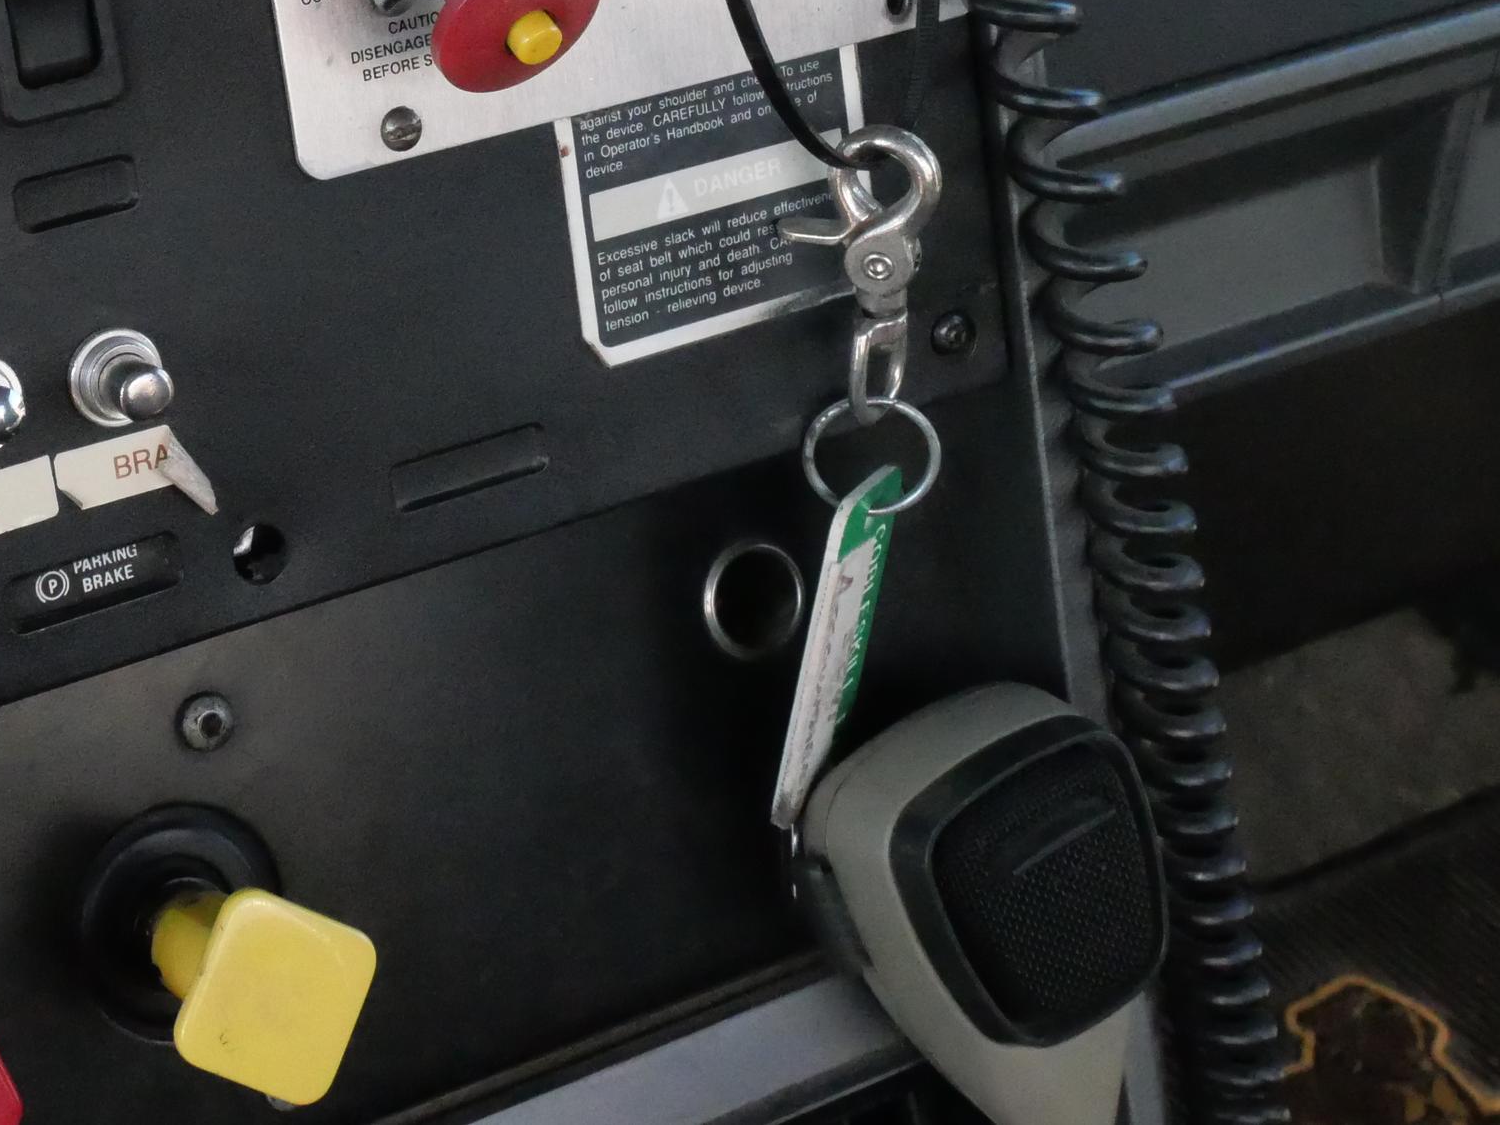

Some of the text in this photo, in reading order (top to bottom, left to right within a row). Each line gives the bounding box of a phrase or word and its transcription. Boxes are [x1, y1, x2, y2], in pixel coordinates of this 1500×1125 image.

[388, 11, 440, 35] CAUTIO
[362, 58, 420, 82] BEFORE
[628, 103, 652, 121] your
[658, 88, 707, 111] shoulder
[714, 81, 735, 96] and
[740, 74, 760, 89] che
[780, 64, 794, 78] To
[800, 60, 820, 74] use
[581, 133, 600, 147] the
[653, 98, 726, 128] CAREFULLY
[732, 89, 765, 107] follow
[785, 72, 833, 92] tructions
[584, 151, 595, 163] in
[600, 135, 661, 159] Operator's
[666, 115, 725, 142] Handbook
[730, 108, 752, 125] and
[757, 104, 772, 117] on
[807, 89, 818, 105] of
[693, 157, 783, 199] DANGER
[597, 192, 831, 266] Excessive slack will reduce effectiven
[599, 269, 612, 283] of
[617, 262, 644, 277] seat
[649, 252, 672, 269] belt
[678, 240, 713, 260] which
[719, 229, 751, 247] could
[601, 277, 653, 302] personal
[659, 266, 692, 285] injury
[699, 256, 721, 271] and
[603, 251, 794, 316] follow instructions for adjusting
[606, 310, 649, 332] tension
[667, 291, 717, 314] relieving
[113, 443, 162, 479] BRA
[73, 543, 138, 575] PARKING
[82, 564, 135, 593] BRAKE
